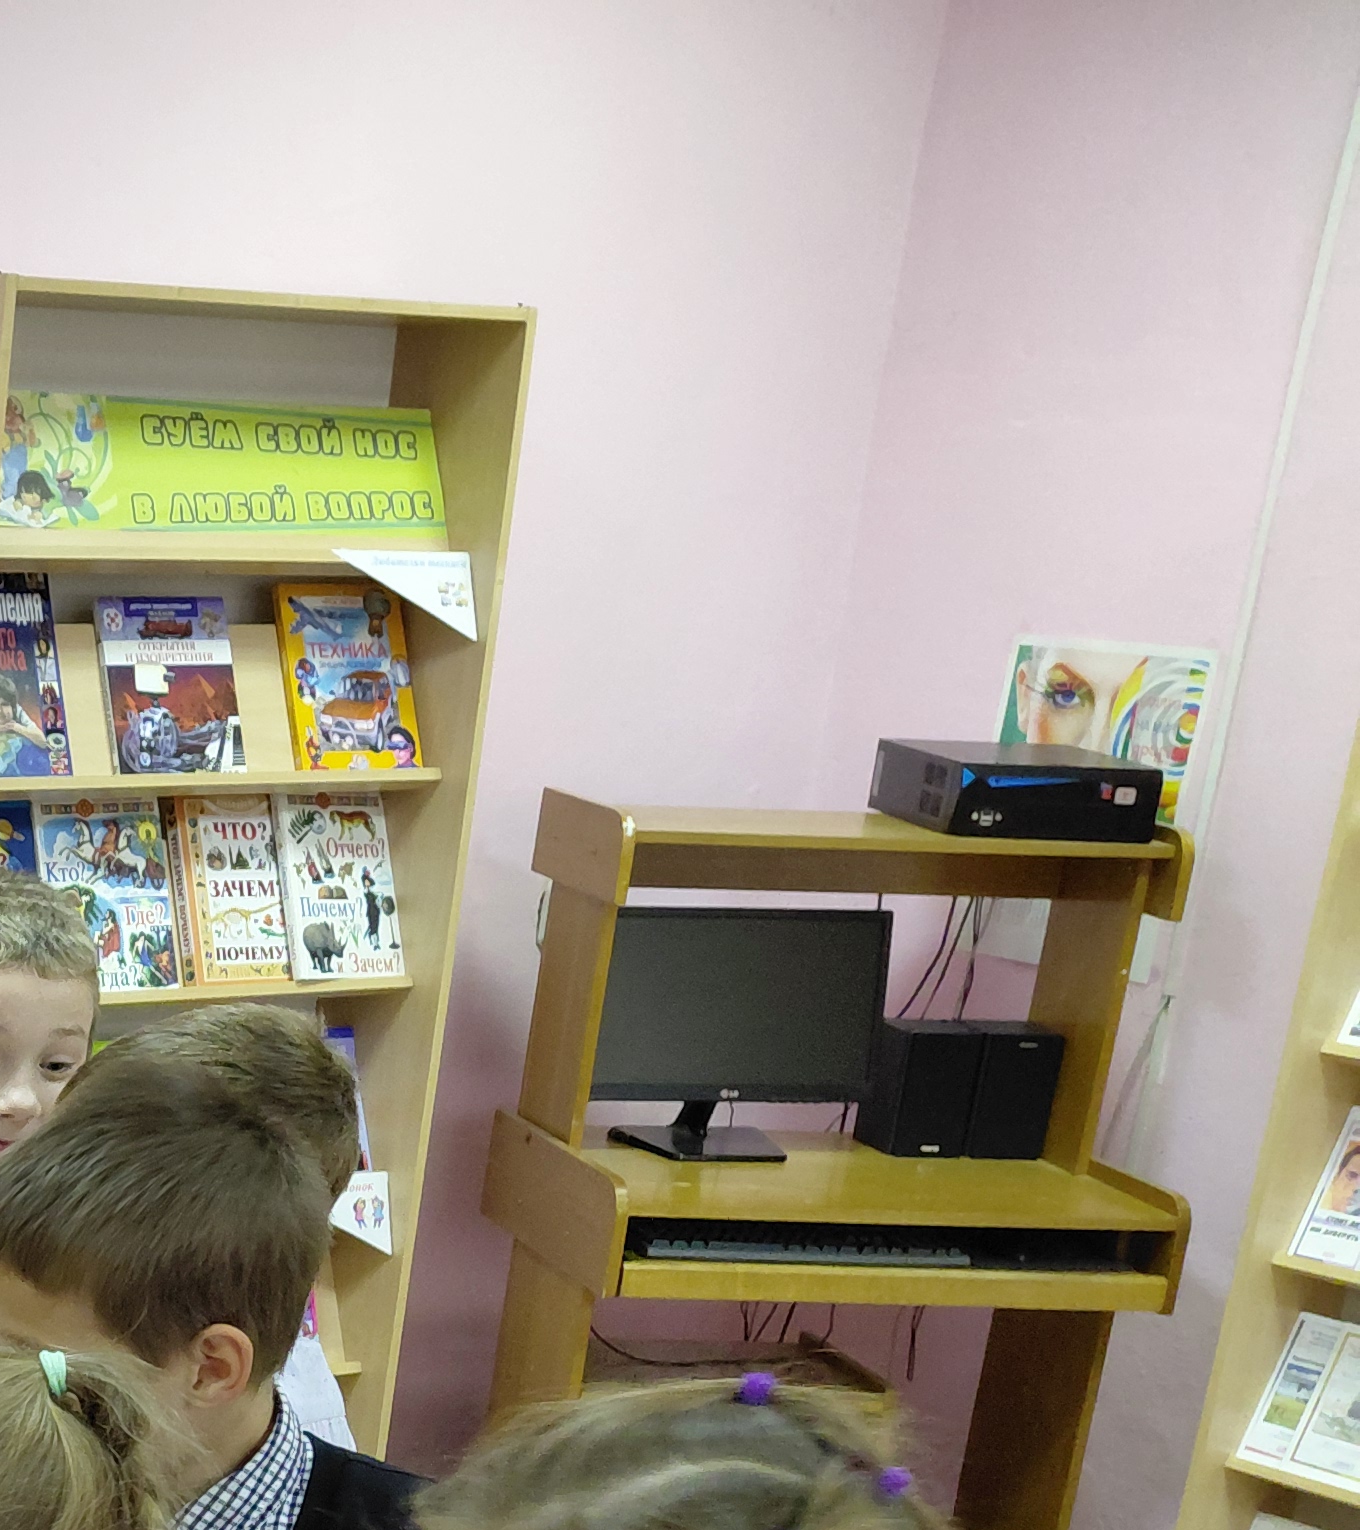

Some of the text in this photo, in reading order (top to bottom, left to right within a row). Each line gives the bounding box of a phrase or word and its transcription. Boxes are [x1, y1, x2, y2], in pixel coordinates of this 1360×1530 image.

[140, 412, 418, 460] СУЁМ СВОЙ НОС
[131, 484, 434, 524] В ЛЮБОЙ ВОПРОС
[138, 641, 196, 651] ОТКРЫТИЯ
[306, 642, 389, 658] ТЕХНИКА
[135, 652, 214, 662] ИЗОБРЕТЕНИЯ
[212, 822, 267, 841] ЧТО?
[326, 837, 386, 859] Отчего?
[45, 862, 86, 883] Кто?
[209, 879, 276, 898] ЗАЧЕМ
[124, 905, 165, 926] Где?
[300, 896, 363, 922] Почему?
[216, 946, 285, 961] ПОЧЕМУ
[336, 952, 401, 973] и Зачем?
